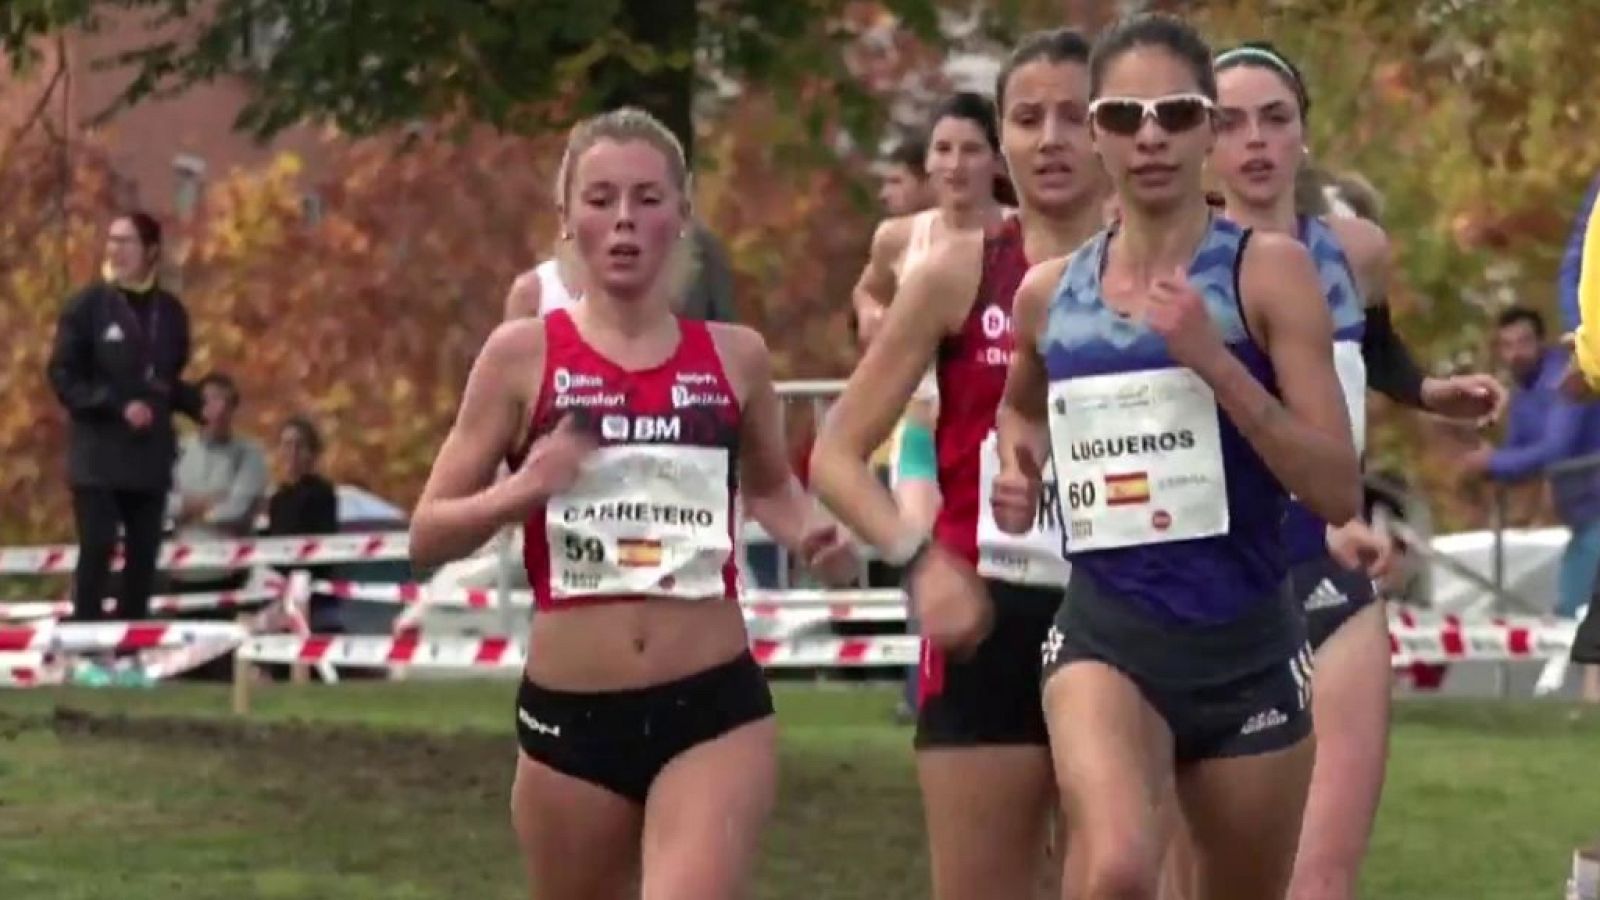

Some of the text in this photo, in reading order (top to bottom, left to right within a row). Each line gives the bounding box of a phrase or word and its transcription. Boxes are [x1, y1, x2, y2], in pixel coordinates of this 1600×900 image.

[635, 416, 681, 440] BM
[1071, 430, 1195, 461] LUGUEROS
[1069, 480, 1096, 509] 60
[563, 502, 713, 526] CARRETERO
[565, 530, 605, 563] 59
